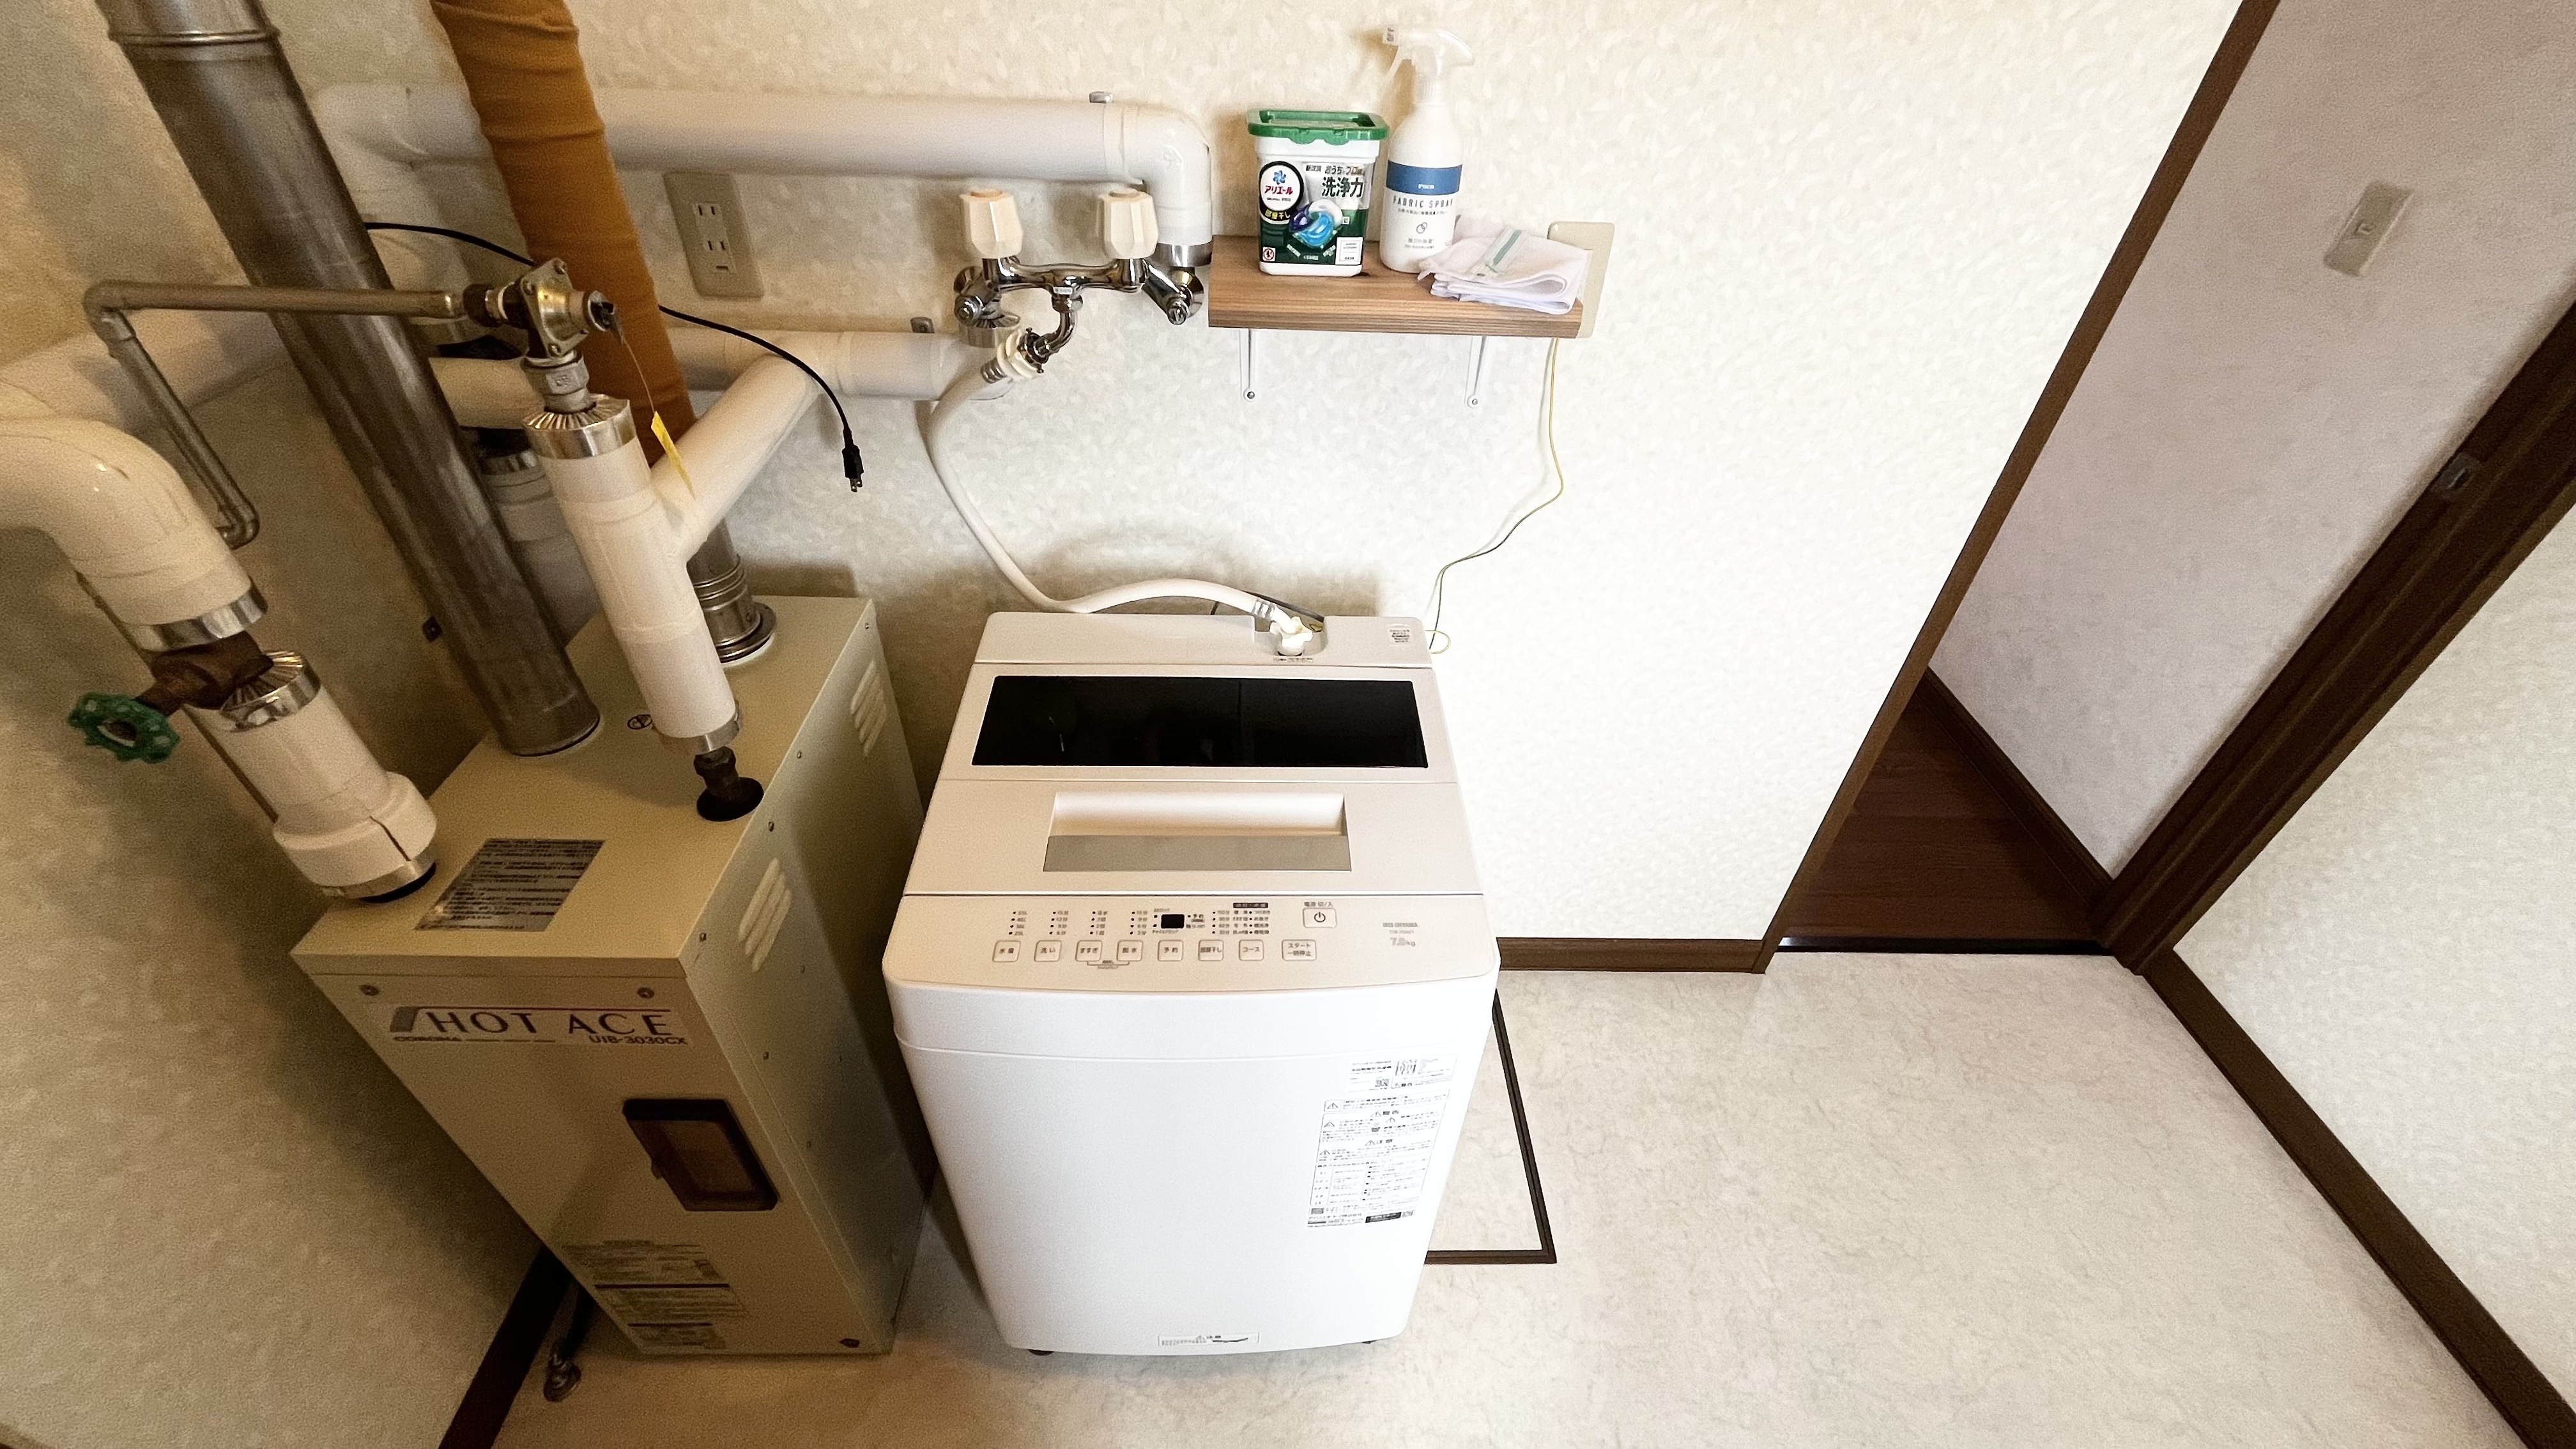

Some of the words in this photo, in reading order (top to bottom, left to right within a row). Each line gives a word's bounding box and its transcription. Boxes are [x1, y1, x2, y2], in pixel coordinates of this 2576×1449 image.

[1264, 185, 1294, 195] アリエール
[1322, 176, 1363, 197] 洗浄力
[1393, 195, 1424, 208] FABRIC
[426, 1011, 539, 1034] HOT
[569, 1013, 672, 1036] ACE
